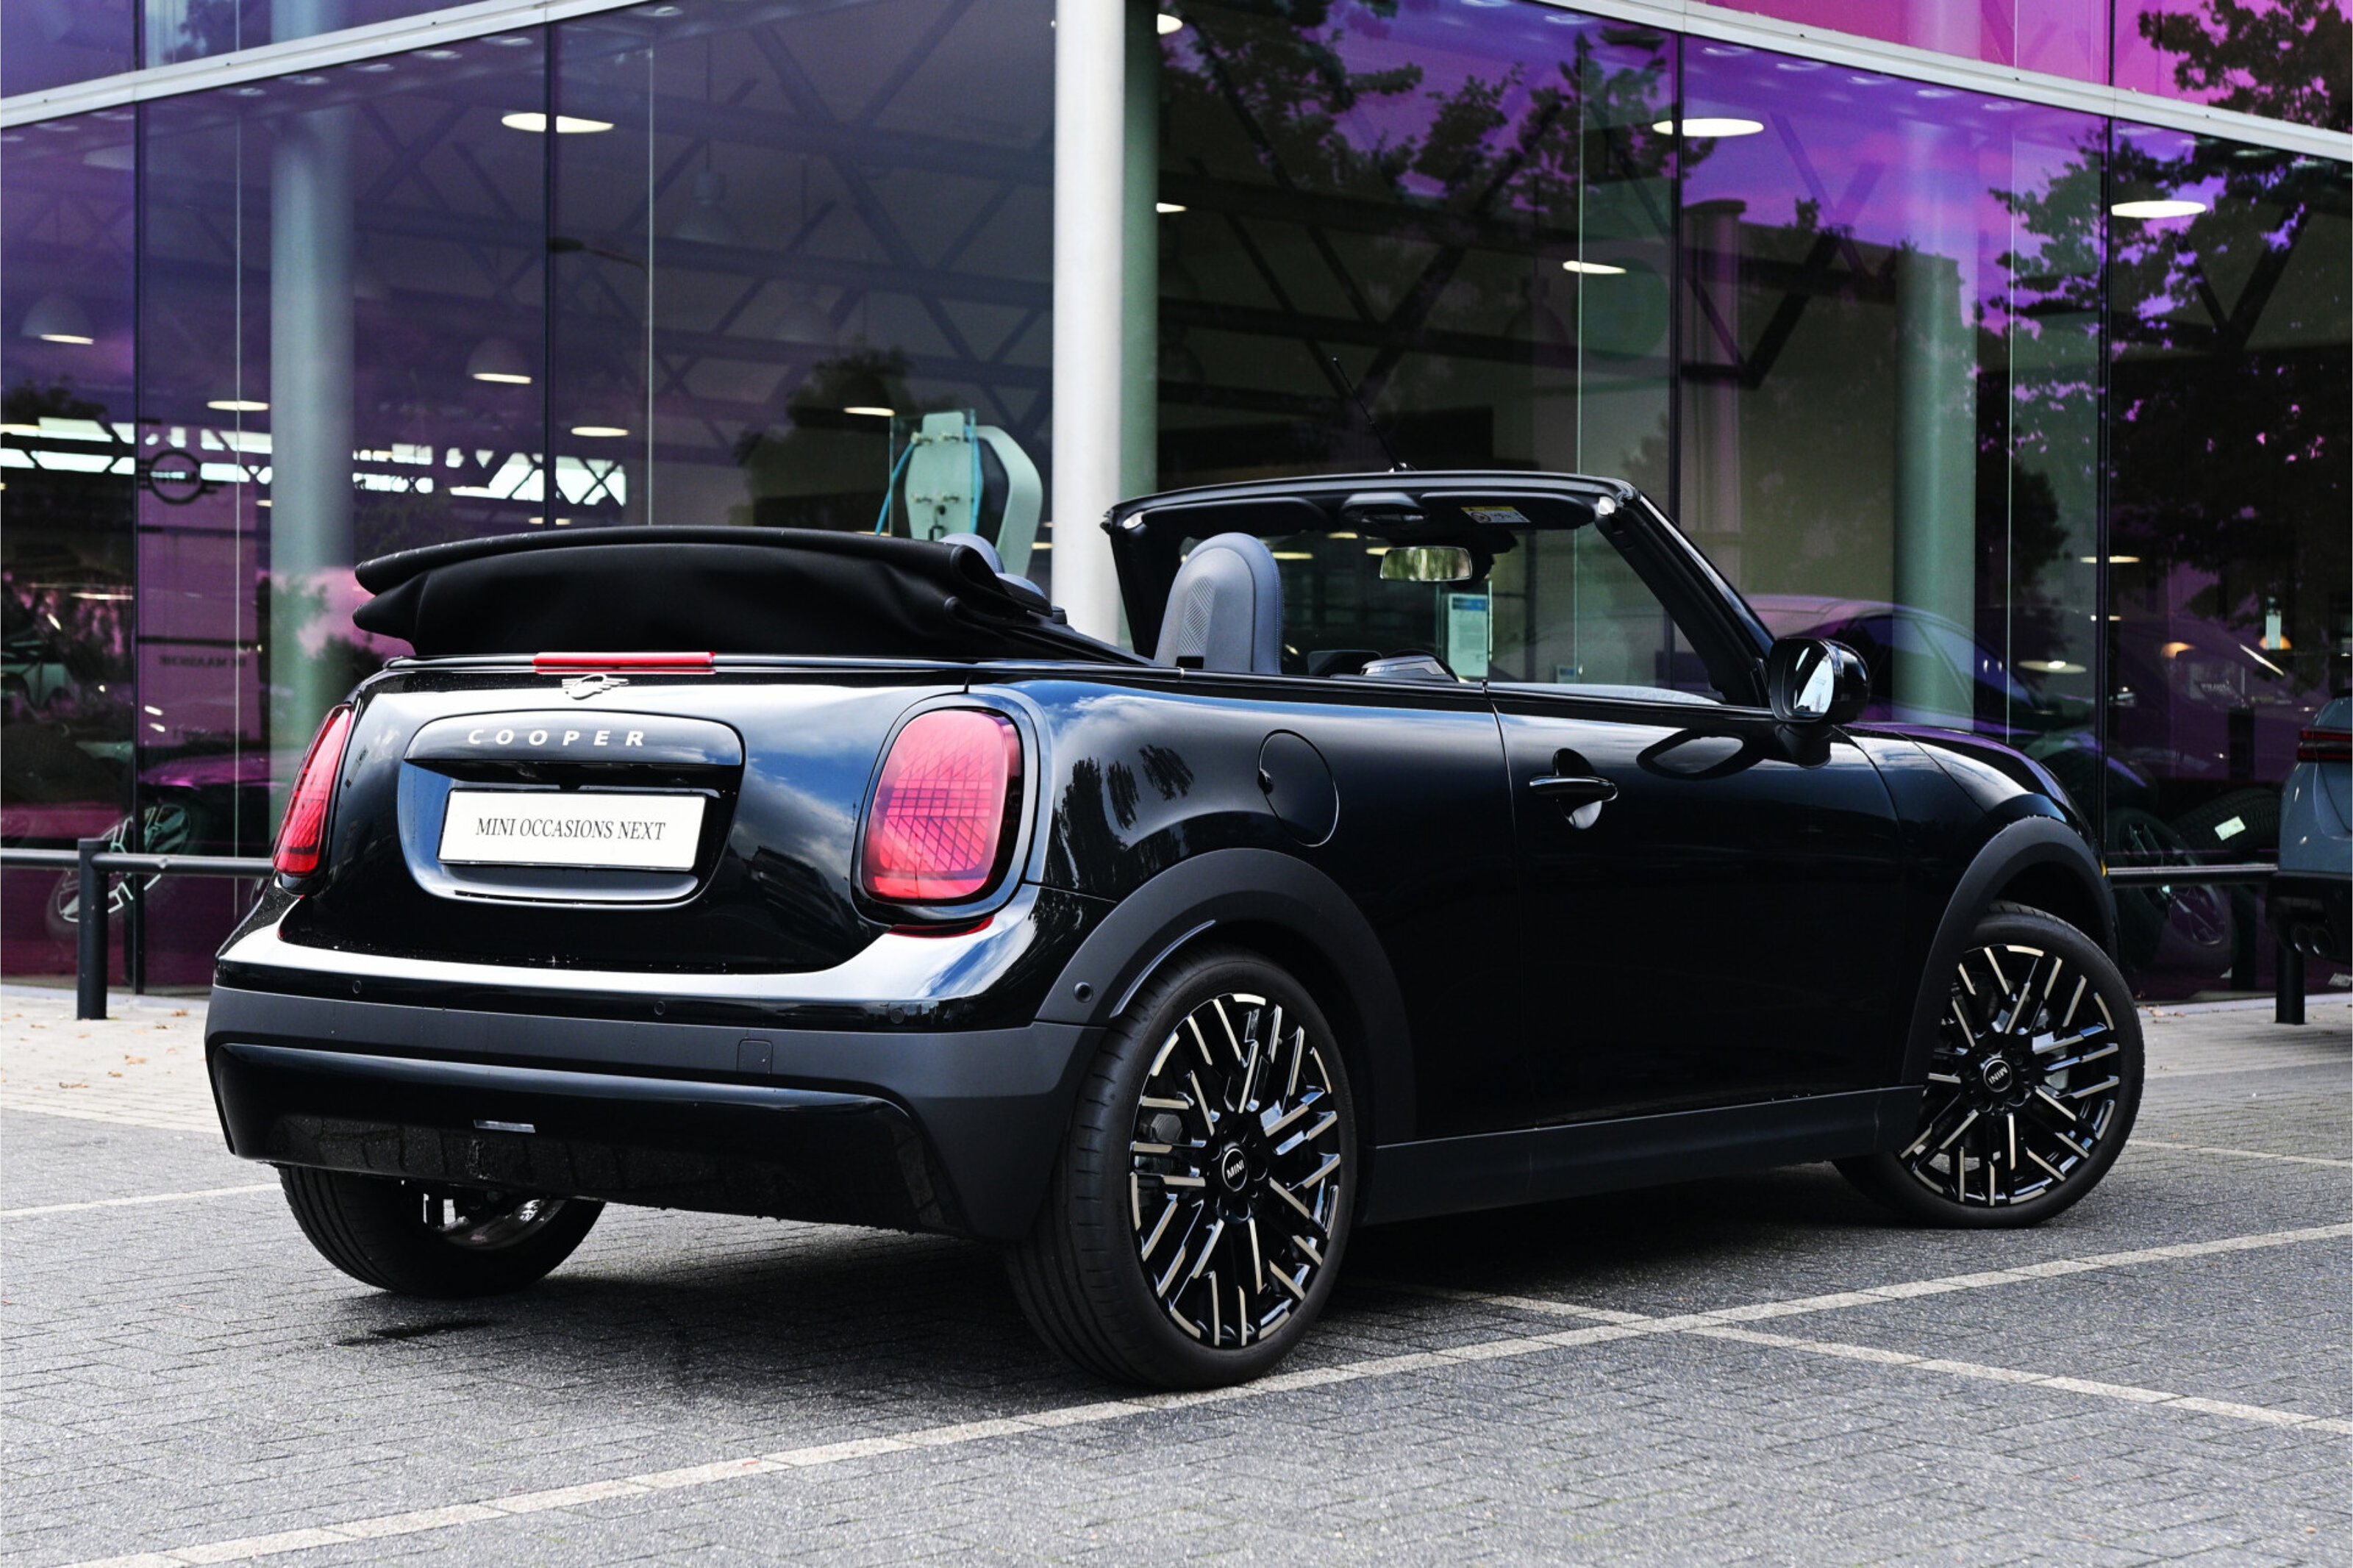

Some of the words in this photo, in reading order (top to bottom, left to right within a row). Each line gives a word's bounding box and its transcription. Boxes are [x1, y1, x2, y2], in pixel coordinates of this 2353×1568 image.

[468, 728, 645, 746] COOPER
[476, 818, 515, 835] MINI
[520, 818, 613, 839] OCCASIONS
[618, 821, 665, 840] NEXT
[1988, 1066, 2008, 1085] MINI
[1226, 1159, 1245, 1180] MINI
